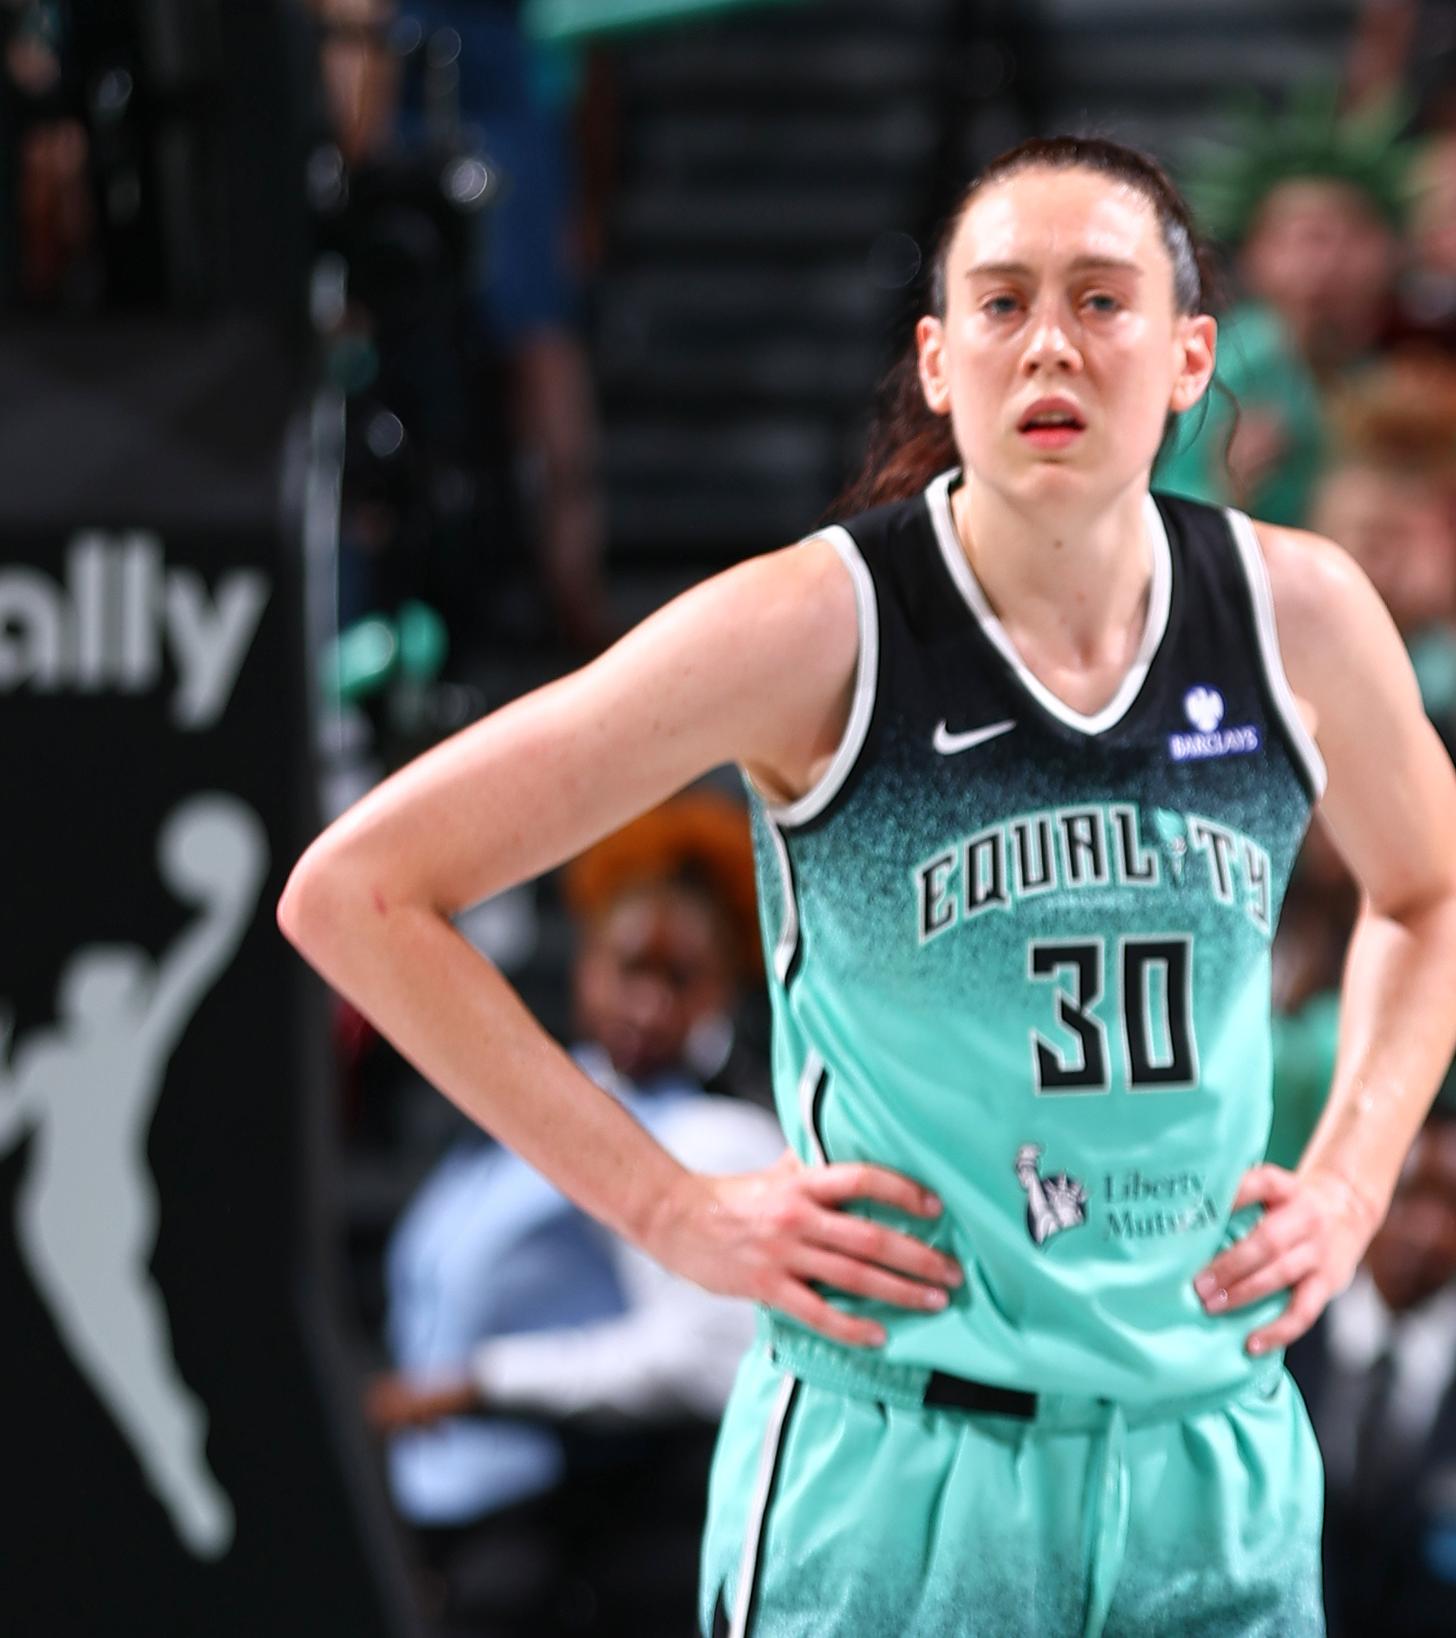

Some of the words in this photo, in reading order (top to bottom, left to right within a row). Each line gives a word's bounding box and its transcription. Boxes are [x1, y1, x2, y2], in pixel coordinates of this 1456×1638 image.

[1170, 726, 1258, 760] BARCLAYS
[1028, 936, 1199, 1096] 30
[1104, 1169, 1206, 1203] Liberty
